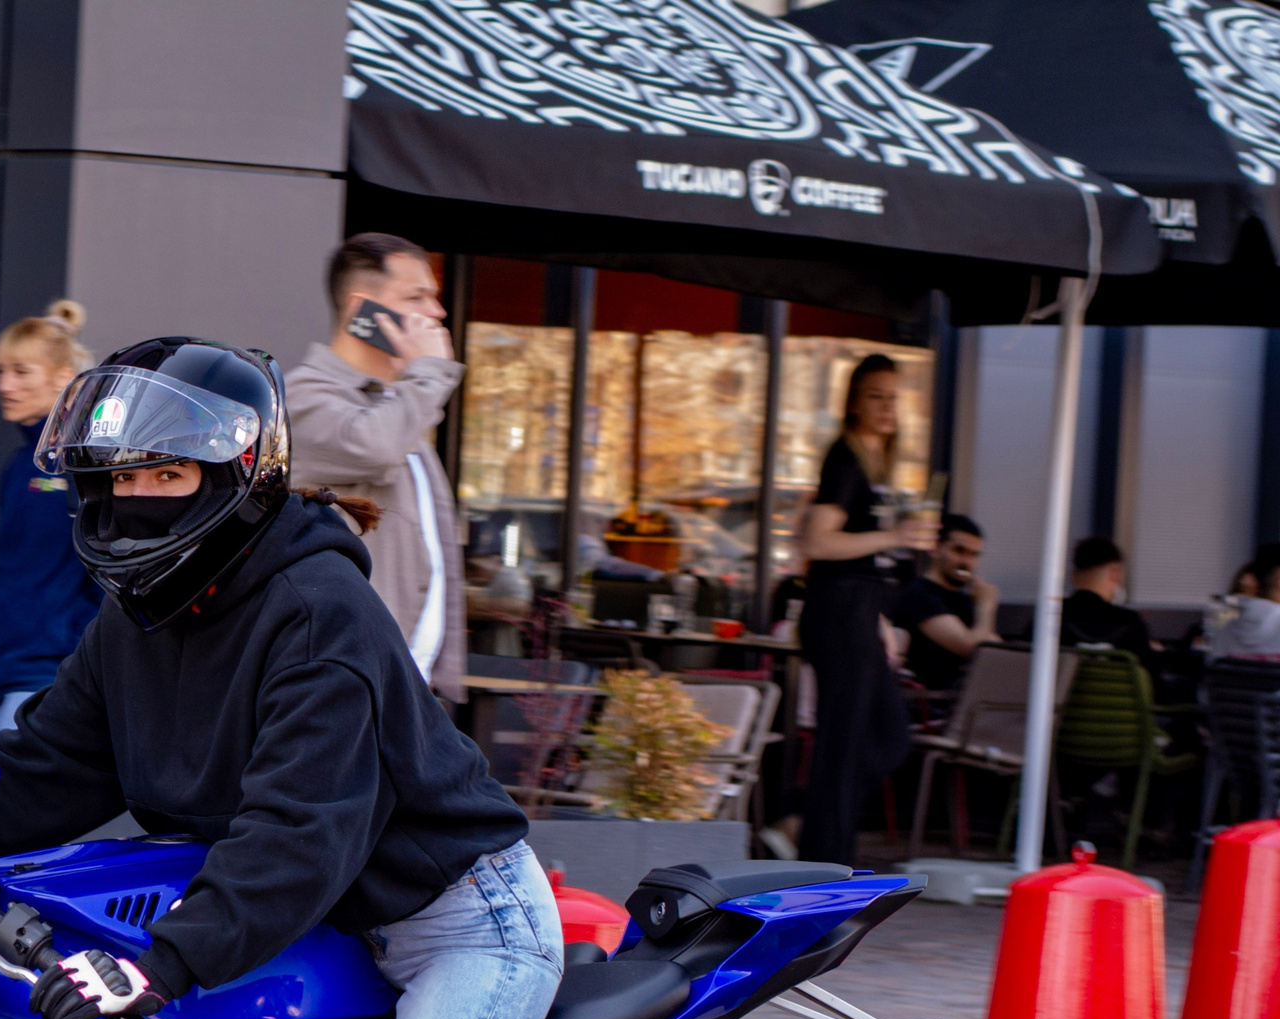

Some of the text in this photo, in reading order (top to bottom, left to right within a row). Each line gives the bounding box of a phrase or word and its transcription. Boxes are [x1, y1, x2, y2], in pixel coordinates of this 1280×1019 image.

[636, 160, 888, 214] TUCANO COFFEE
[93, 420, 120, 436] agv
